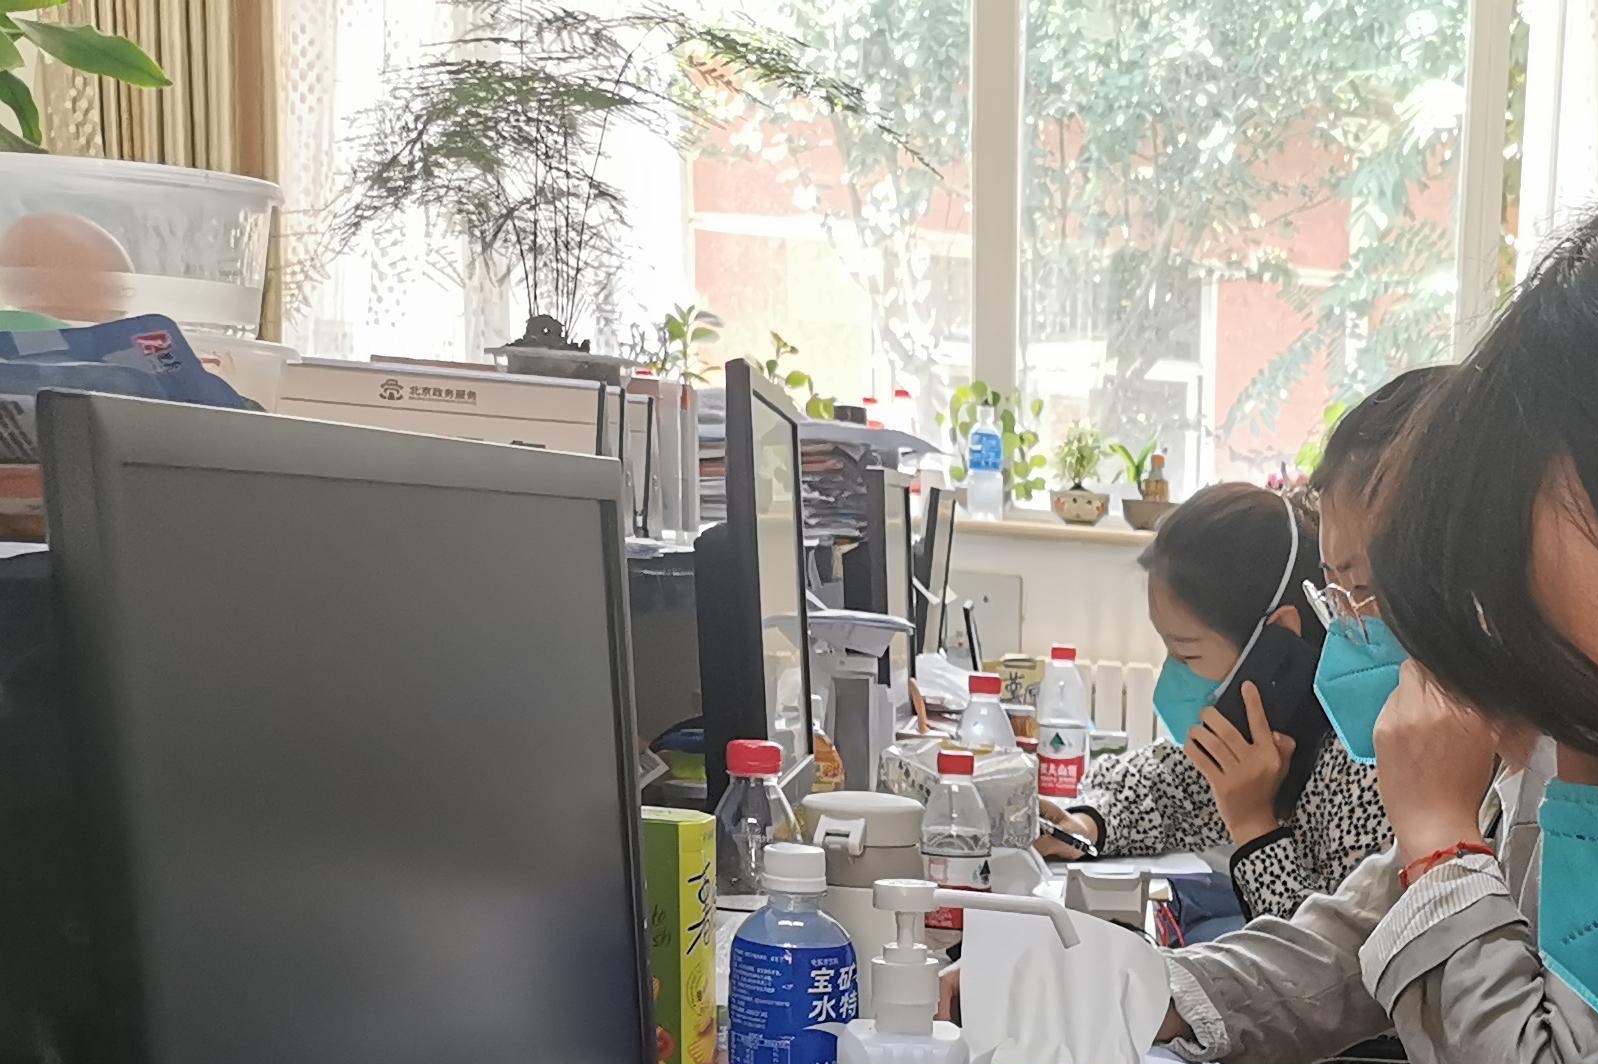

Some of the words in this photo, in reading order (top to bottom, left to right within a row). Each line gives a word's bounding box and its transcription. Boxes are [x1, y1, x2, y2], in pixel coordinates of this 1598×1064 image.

[408, 385, 477, 401] 北京政务服务
